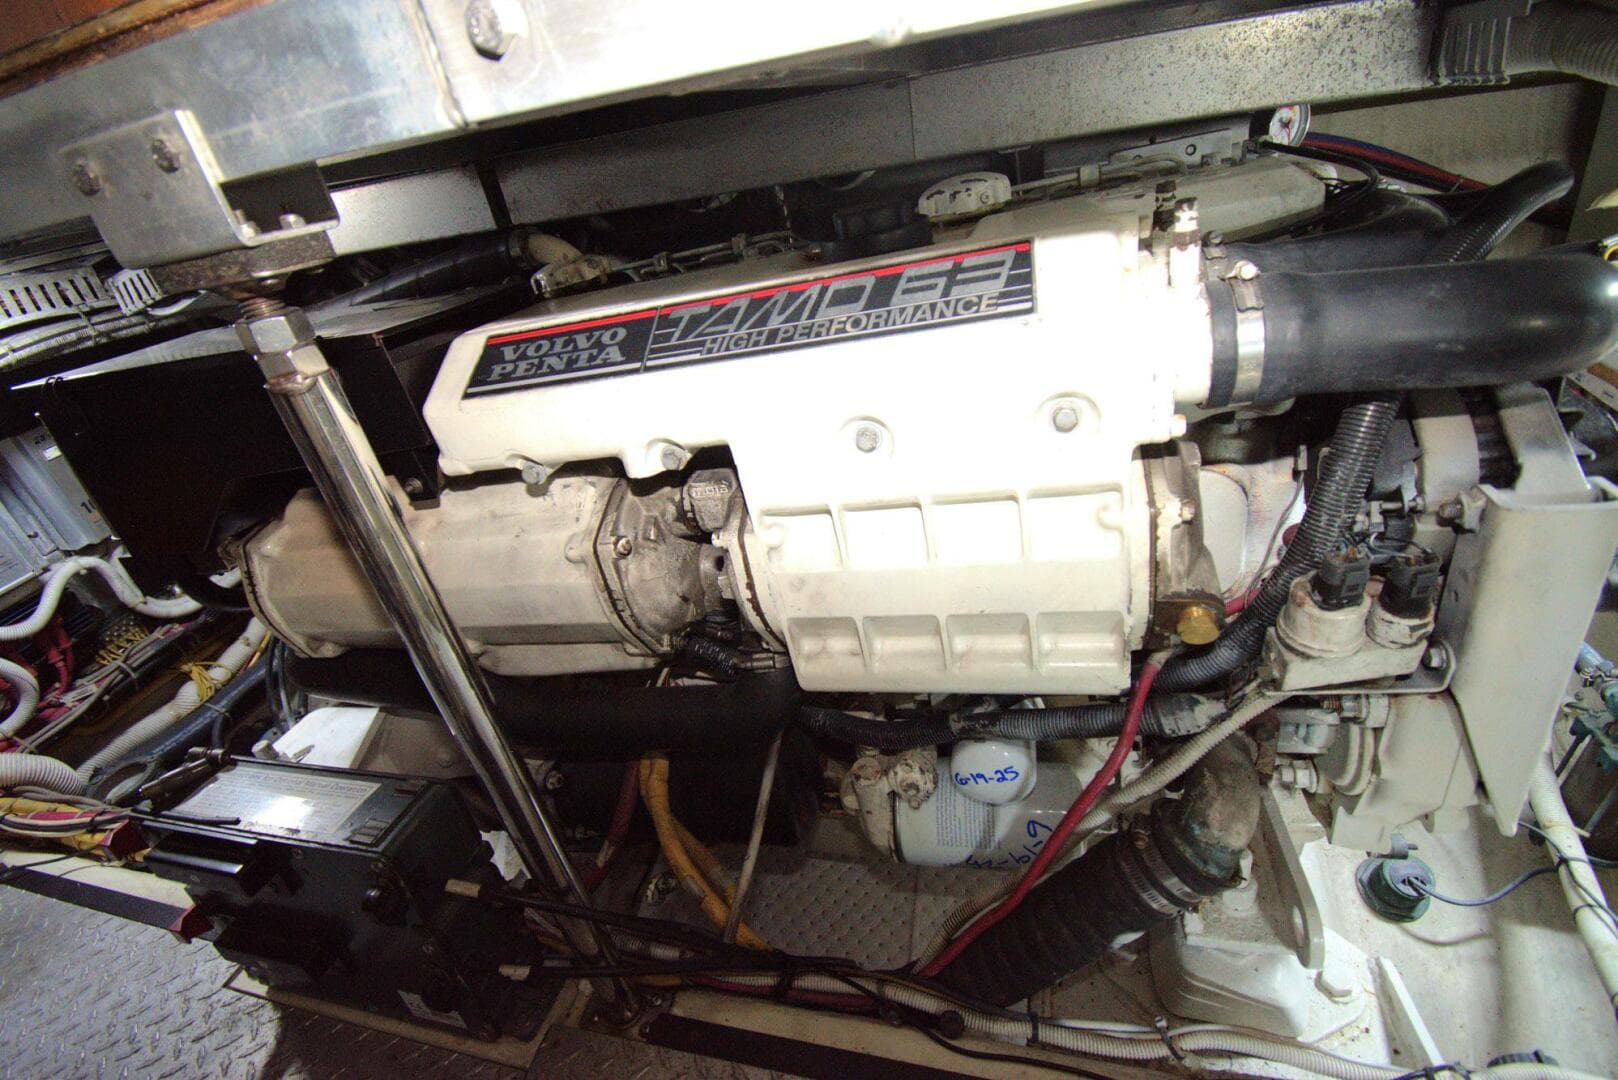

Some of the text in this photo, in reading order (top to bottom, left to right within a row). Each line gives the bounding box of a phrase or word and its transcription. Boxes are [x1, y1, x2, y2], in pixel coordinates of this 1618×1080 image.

[669, 249, 1017, 343] TAMD 63
[701, 292, 999, 355] HIGH PERFORMANCE
[500, 327, 627, 361] VOLVO
[486, 346, 627, 381] PENTA
[954, 765, 1020, 786] 6-19-25
